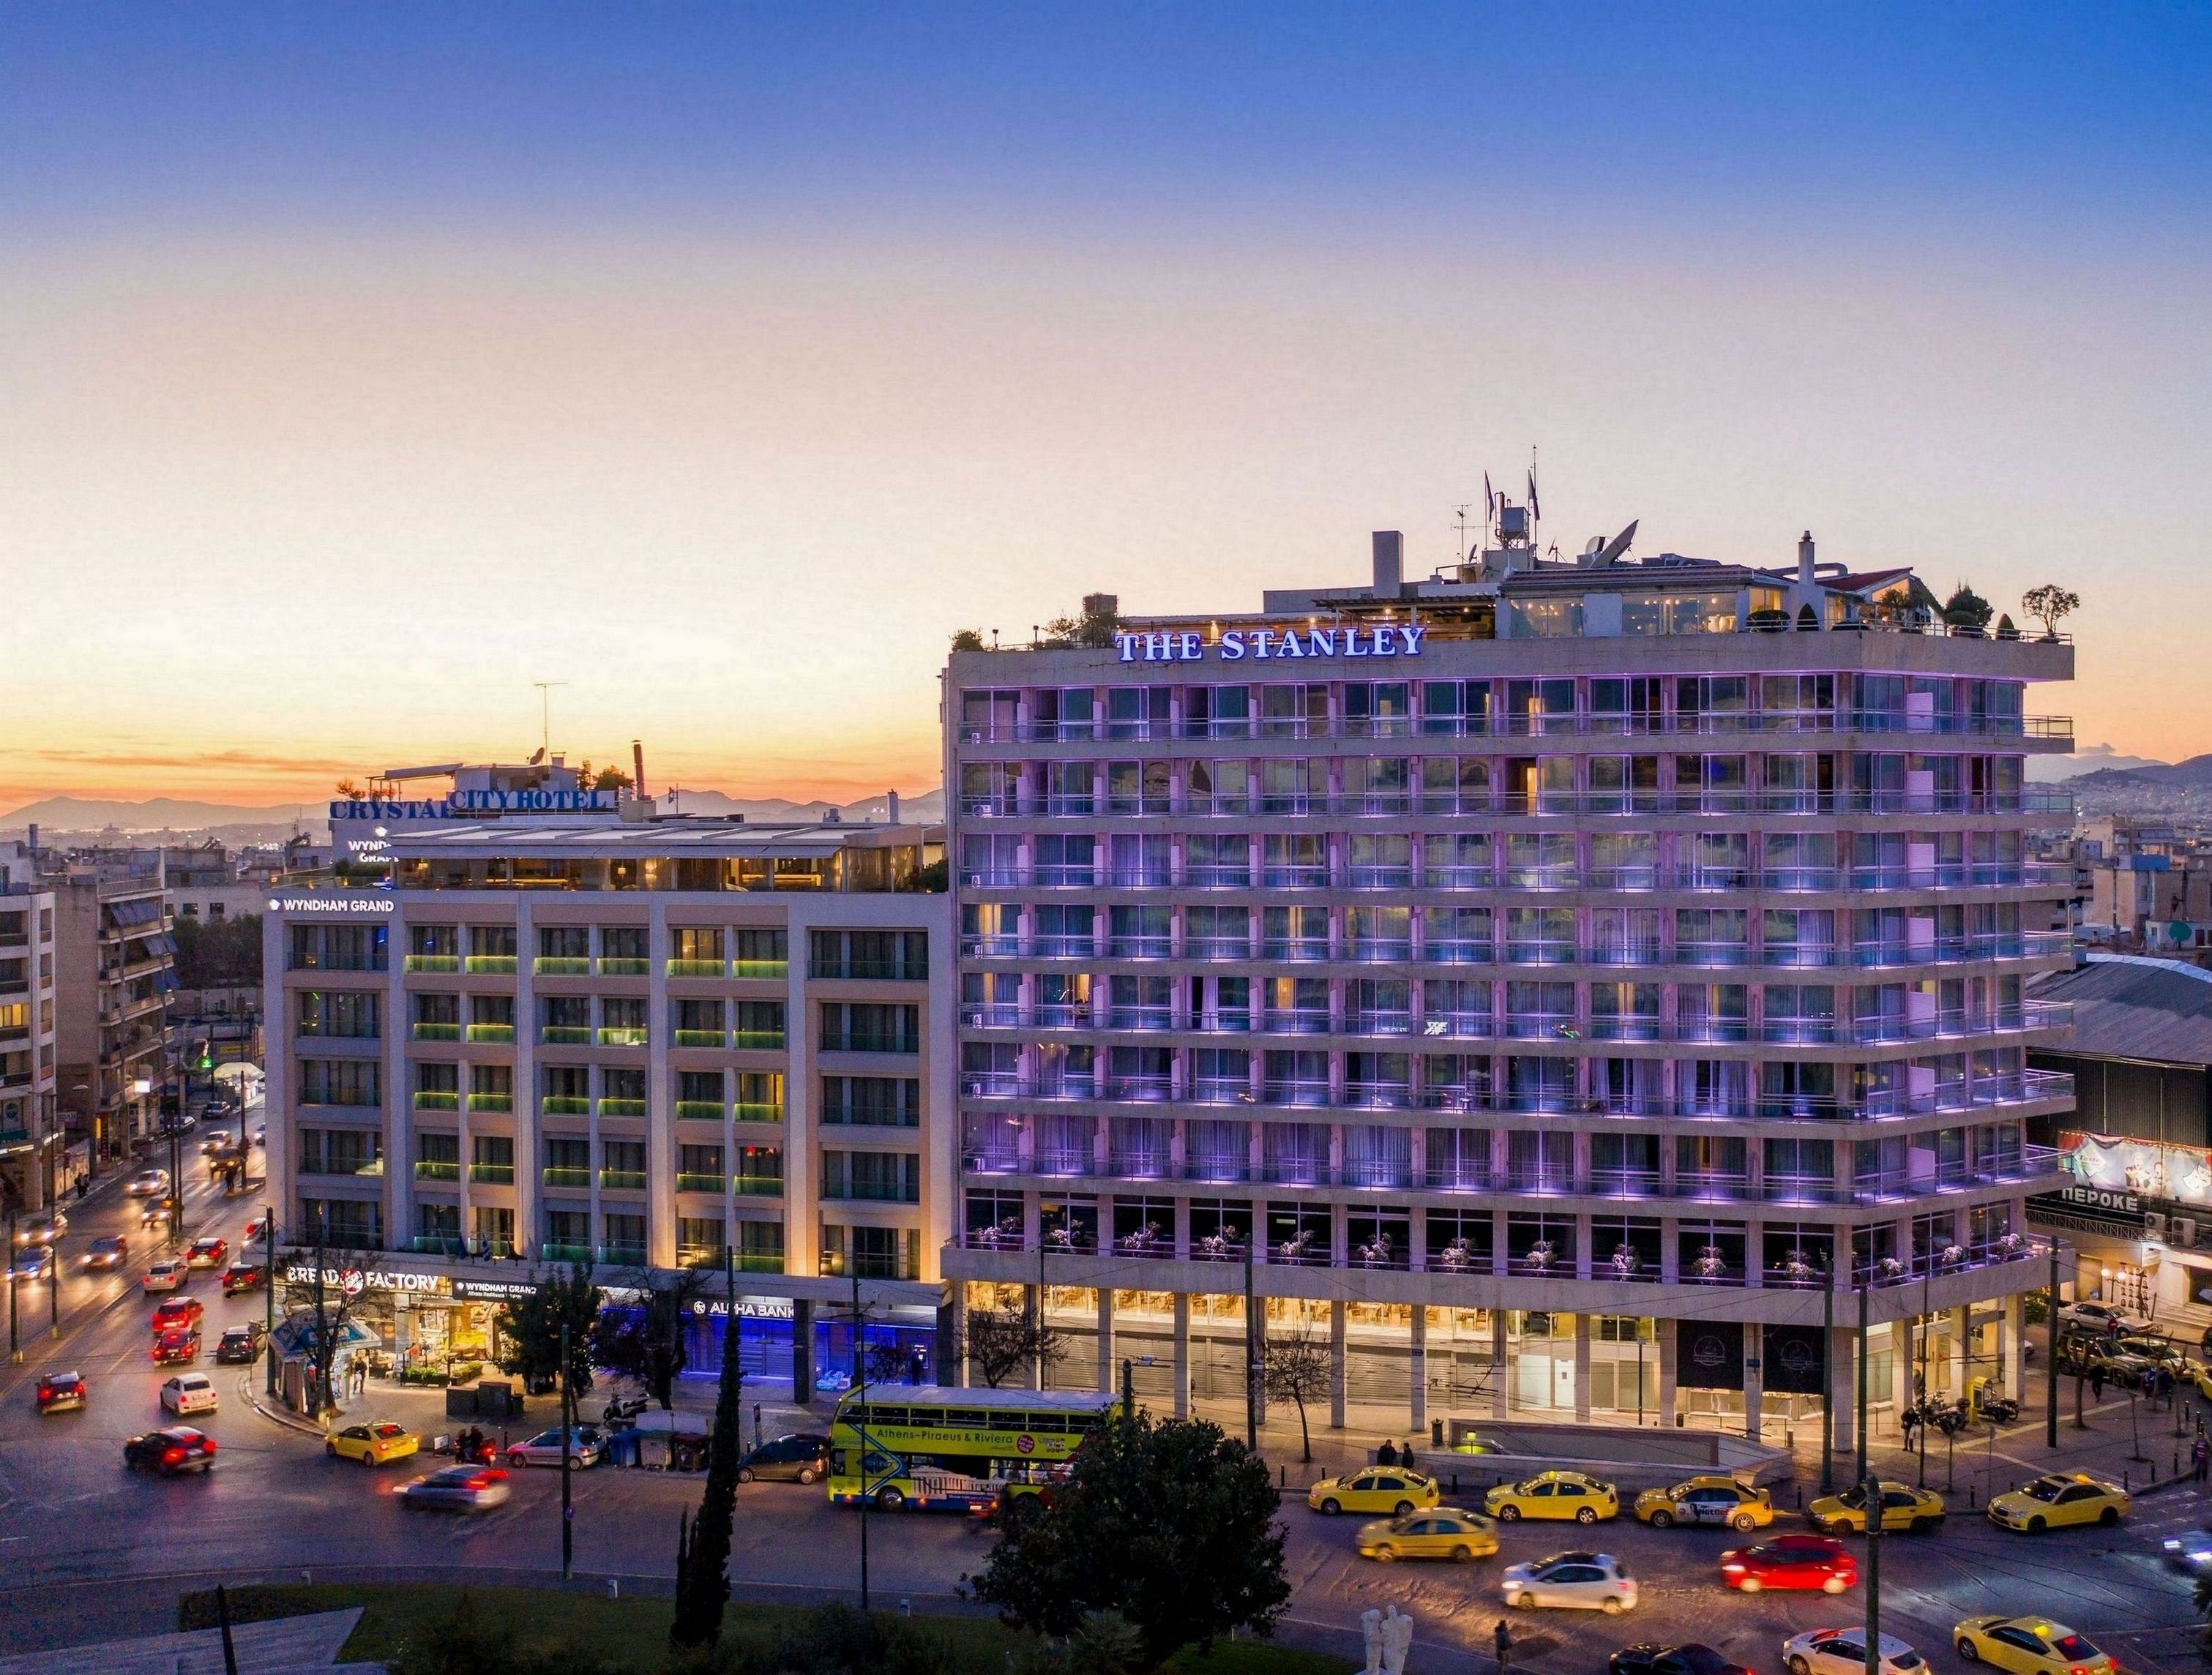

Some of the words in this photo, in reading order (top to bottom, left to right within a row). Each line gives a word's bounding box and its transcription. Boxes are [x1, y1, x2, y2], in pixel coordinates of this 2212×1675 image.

[1115, 632, 1203, 662] THE
[1220, 626, 1426, 659] STANLEY
[348, 840, 392, 851] WYND
[283, 899, 348, 912] WYNDHAM
[350, 899, 395, 913] GRAND
[366, 1271, 440, 1293] FACTORY
[466, 1282, 508, 1292] WYNDHAM
[964, 1433, 971, 1442] &
[974, 1434, 1013, 1444] Riviera
